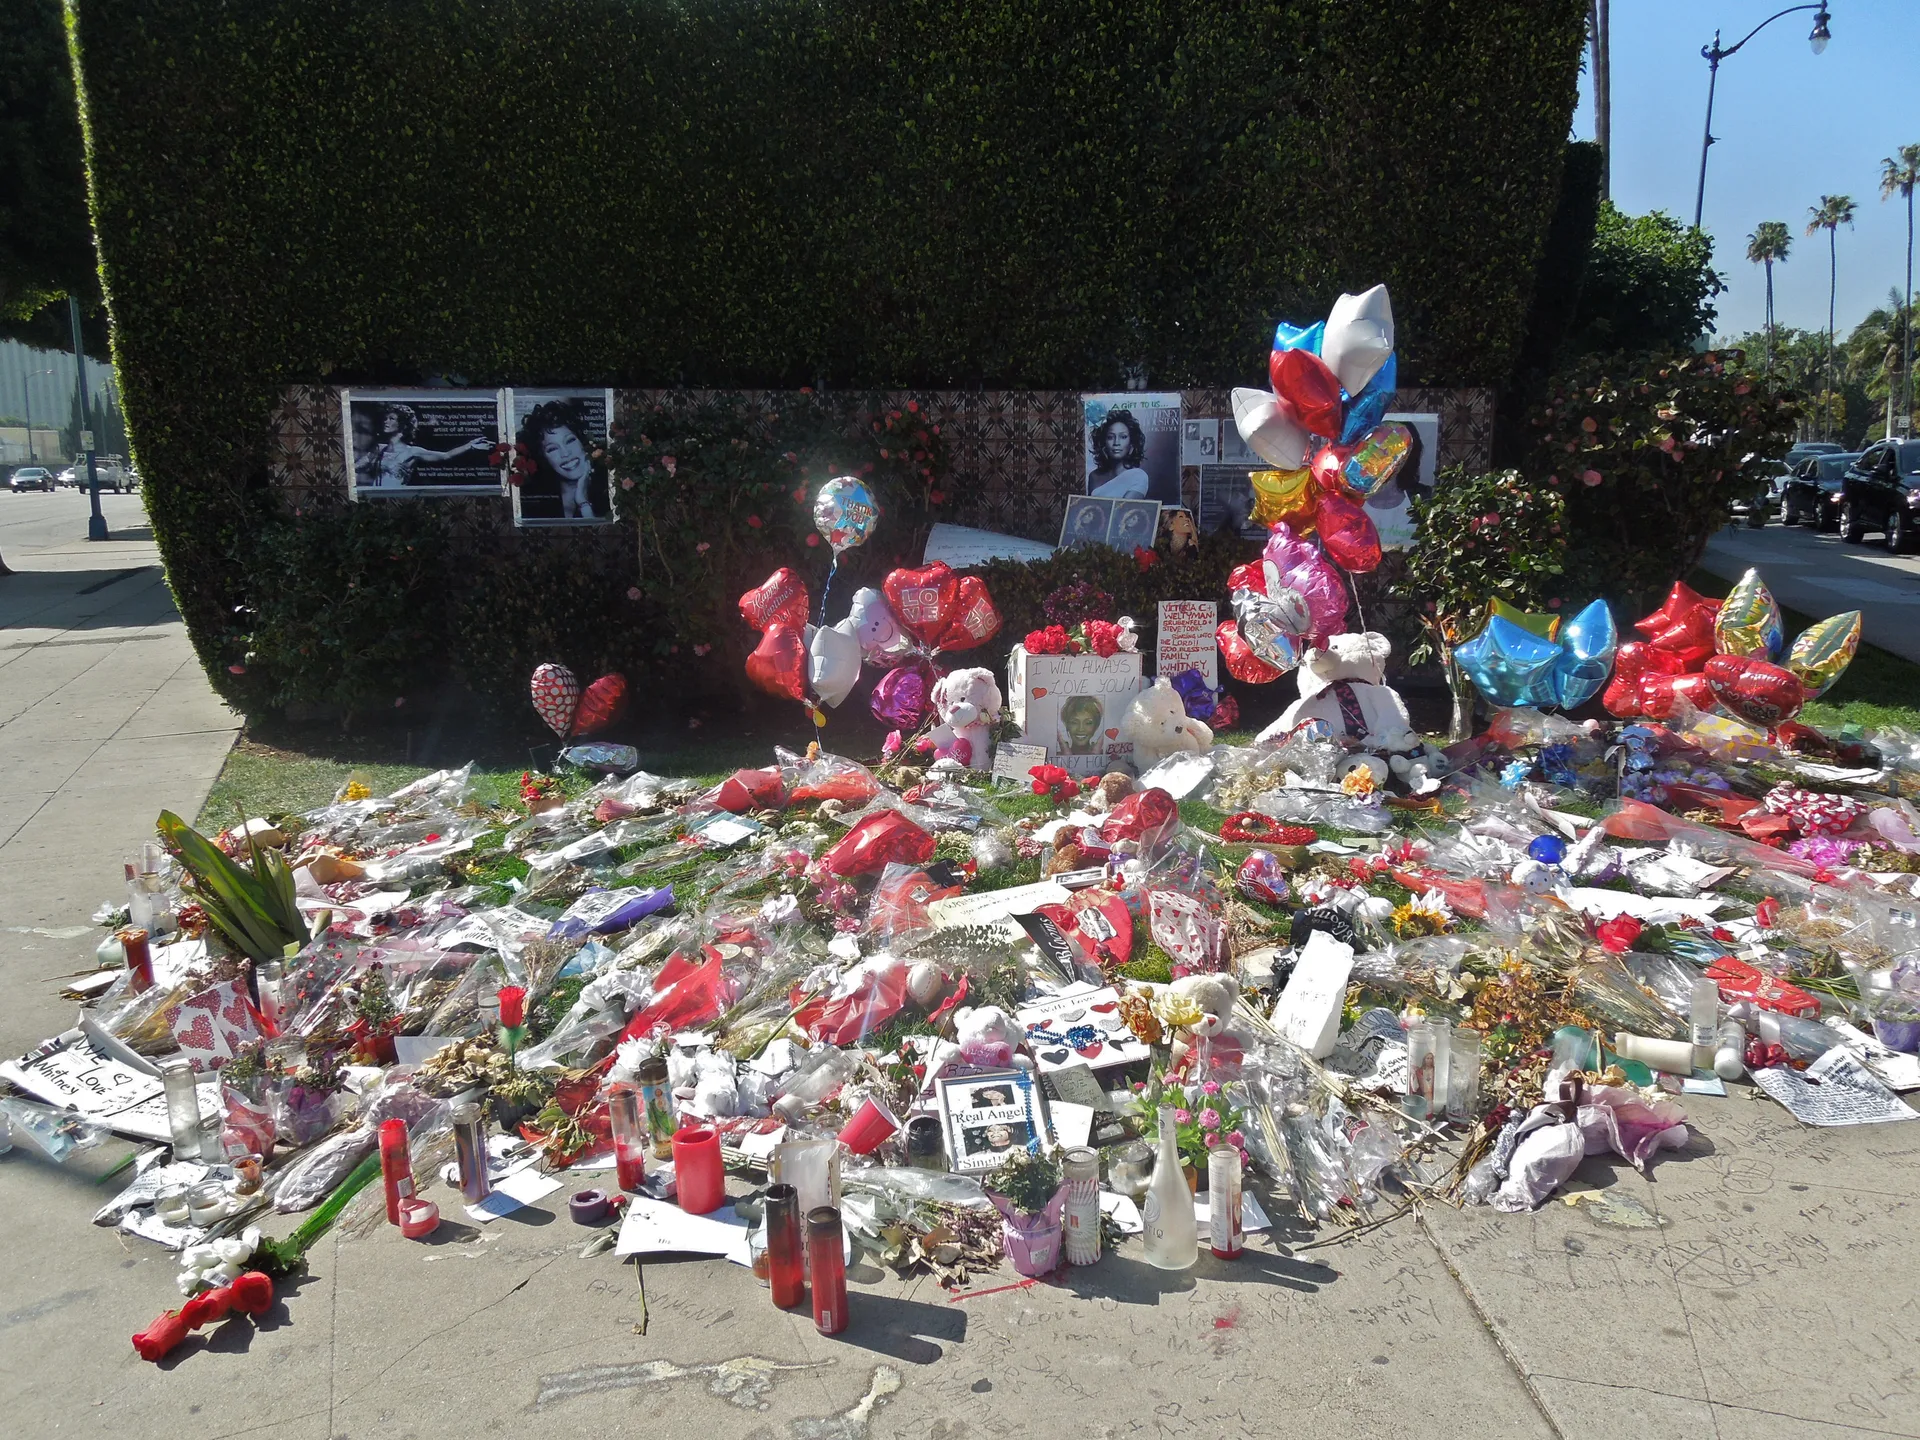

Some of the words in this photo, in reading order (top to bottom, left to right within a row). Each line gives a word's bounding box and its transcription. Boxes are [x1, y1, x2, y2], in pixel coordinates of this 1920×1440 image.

[841, 495, 872, 517] THANK
[845, 509, 865, 525] YOU
[744, 581, 779, 614] Happy
[1032, 660, 1042, 676] I
[1081, 658, 1131, 675] ALWAYS
[1159, 659, 1208, 672] WHITNEY
[1160, 652, 1191, 660] FAMILY
[1048, 678, 1089, 696] LOVE
[1303, 907, 1354, 945] Blooms
[1040, 916, 1074, 965] Blooms
[75, 1033, 113, 1066] WE
[32, 1059, 80, 1096] Whitney
[76, 1066, 109, 1096] LOVE
